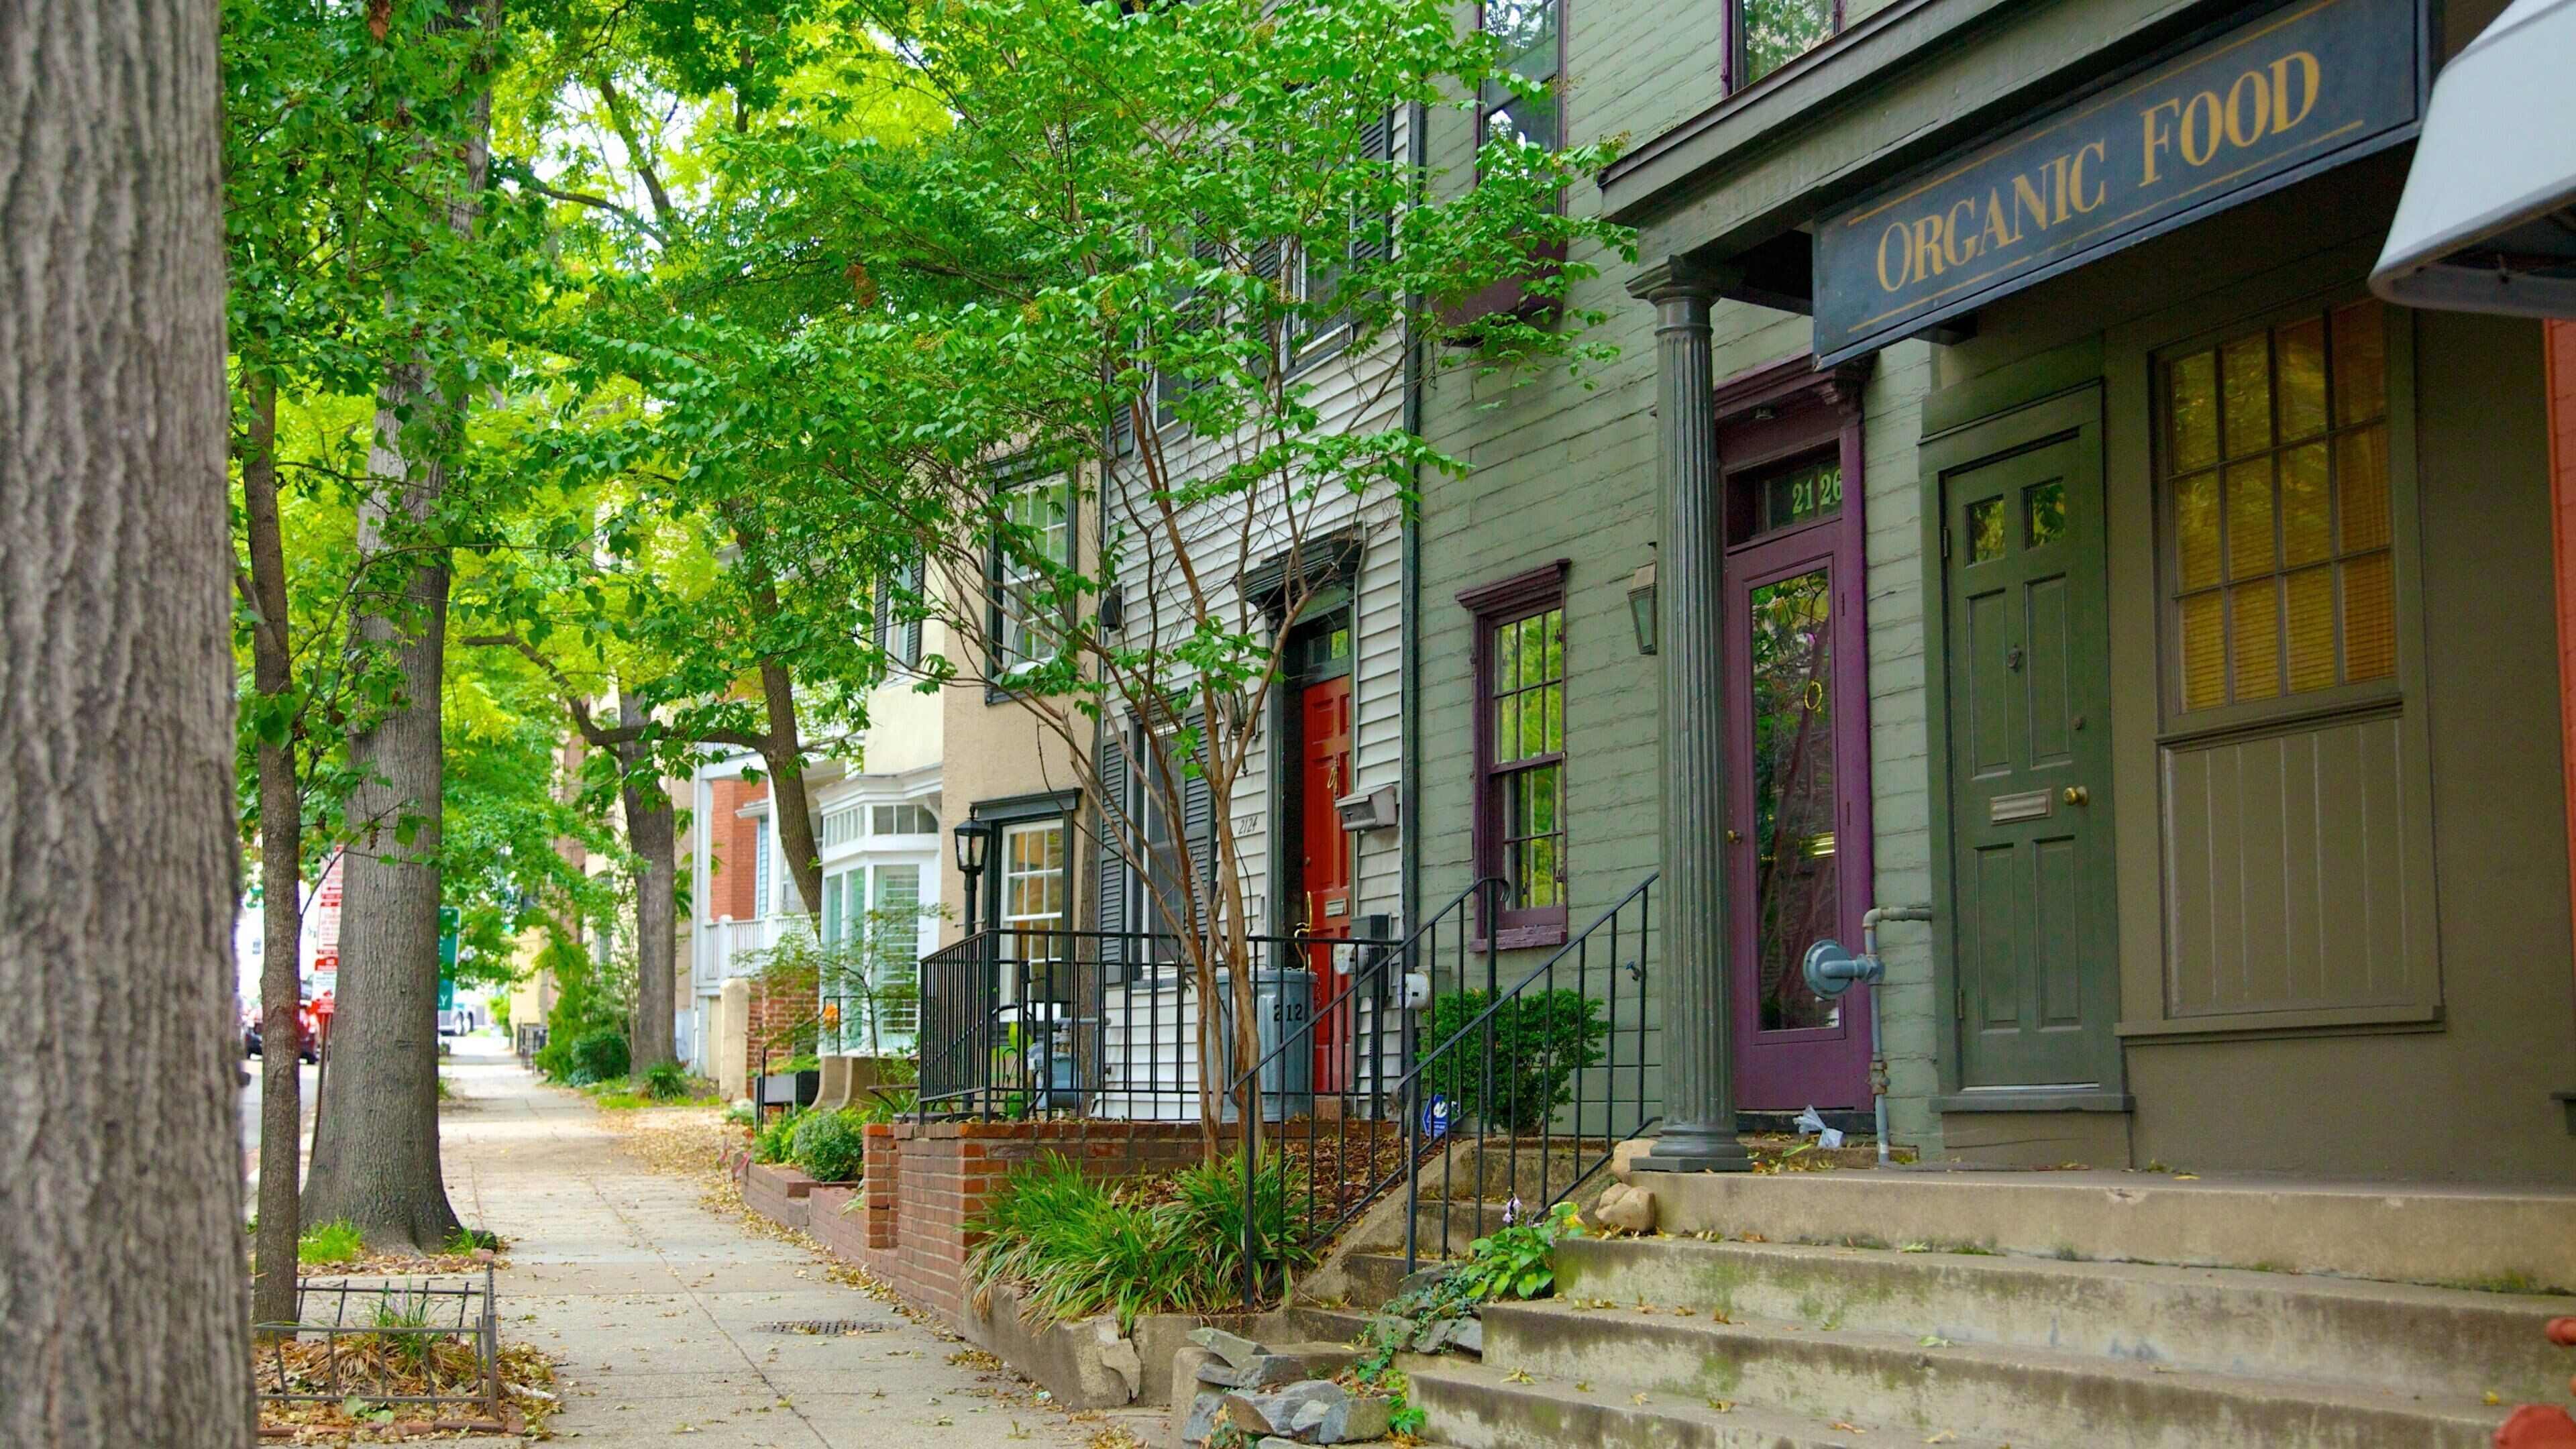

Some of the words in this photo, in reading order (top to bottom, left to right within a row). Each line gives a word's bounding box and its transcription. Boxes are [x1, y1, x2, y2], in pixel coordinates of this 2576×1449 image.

[1878, 138, 2106, 292] ORGANIC
[2138, 51, 2320, 187] FOOD
[1792, 468, 1842, 515] 2126
[1238, 815, 1258, 835] 2124
[1273, 1003, 1310, 1023] 212
